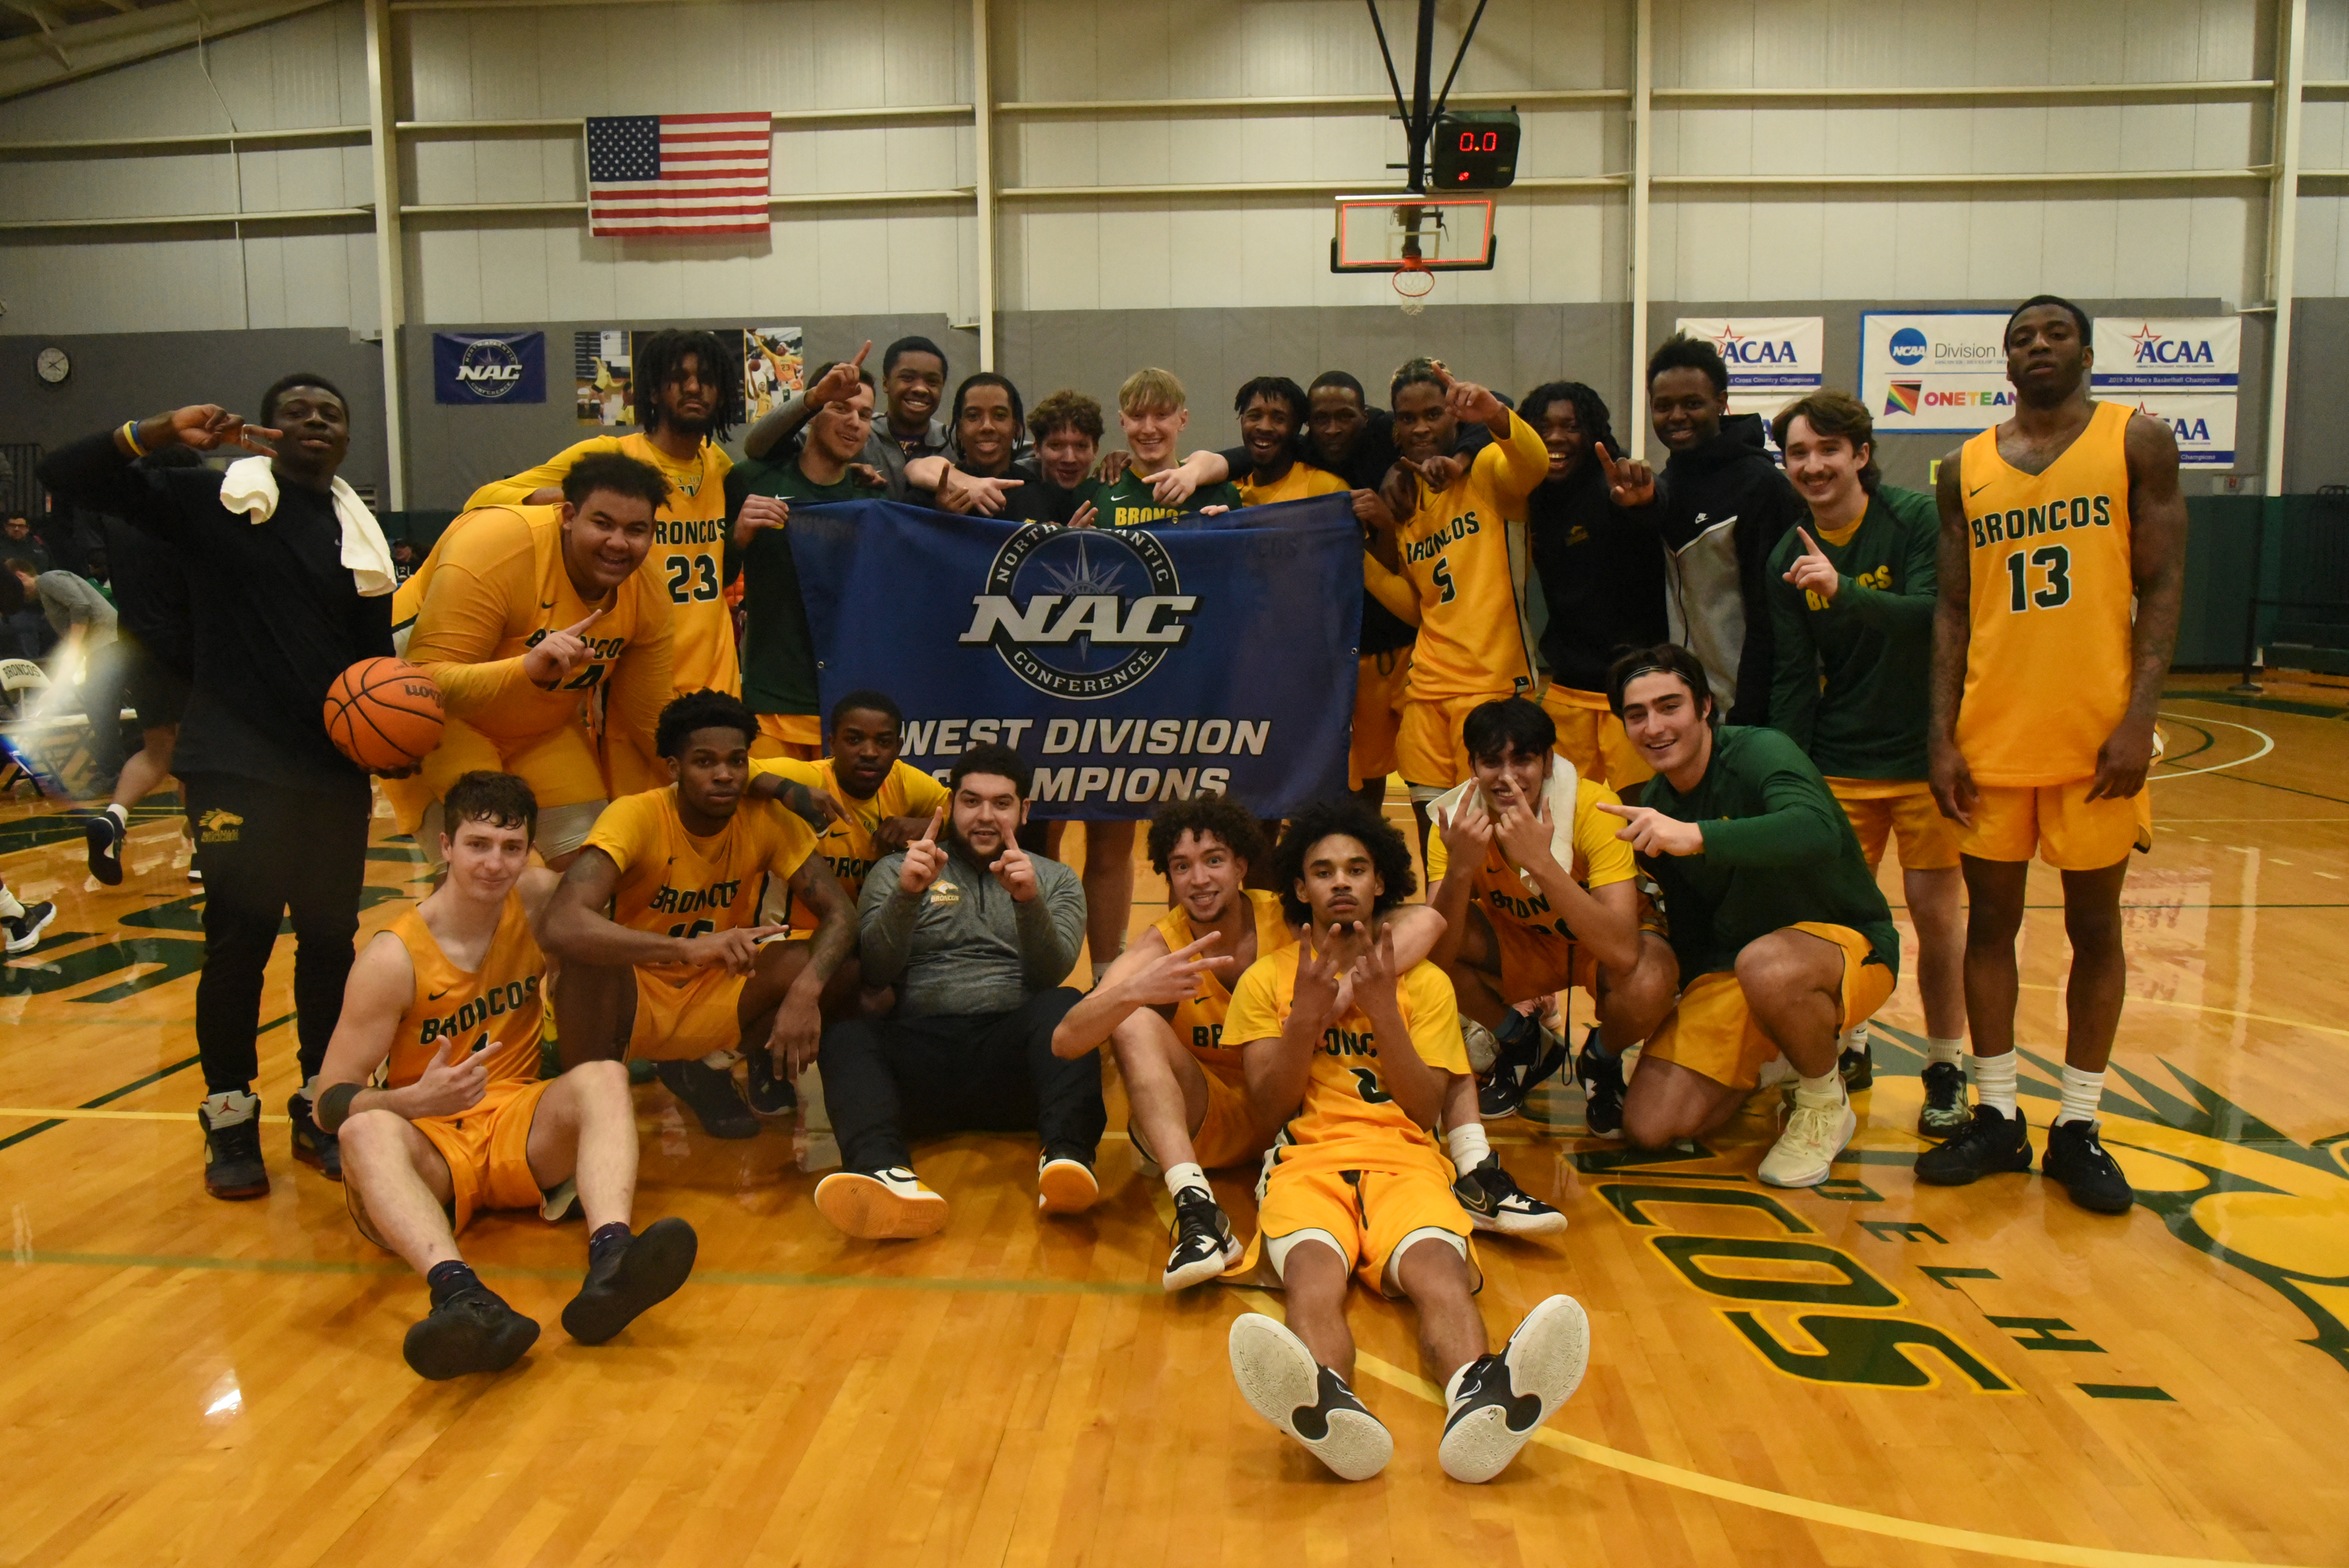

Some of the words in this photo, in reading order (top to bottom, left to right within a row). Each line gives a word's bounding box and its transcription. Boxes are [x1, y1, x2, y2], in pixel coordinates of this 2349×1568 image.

[1459, 132, 1497, 151] 0.0
[1722, 341, 1797, 363] ACAA
[1892, 345, 1927, 357] NCAA
[1935, 343, 1996, 358] Division
[2136, 340, 2214, 363] ACAA
[455, 364, 523, 381] NAC
[1753, 377, 1778, 385] Country
[1780, 377, 1815, 385] Champions
[471, 382, 512, 395] CONFERENCE
[2168, 418, 2210, 440] AA
[1115, 507, 1190, 526] BRONC
[1970, 495, 2111, 548] BRONCOS
[655, 517, 725, 545] RONCOS
[1104, 527, 1170, 582] ANTIC
[665, 553, 719, 604] 23
[1431, 556, 1456, 604] 5
[2006, 544, 2071, 614] 13
[958, 595, 1198, 642] NAC
[524, 628, 626, 660] BNCO
[2, 664, 41, 679] BRONCOS
[1013, 651, 1153, 692] CONFERENCE
[900, 718, 1034, 756] WEST
[1041, 718, 1271, 755] DIVISION
